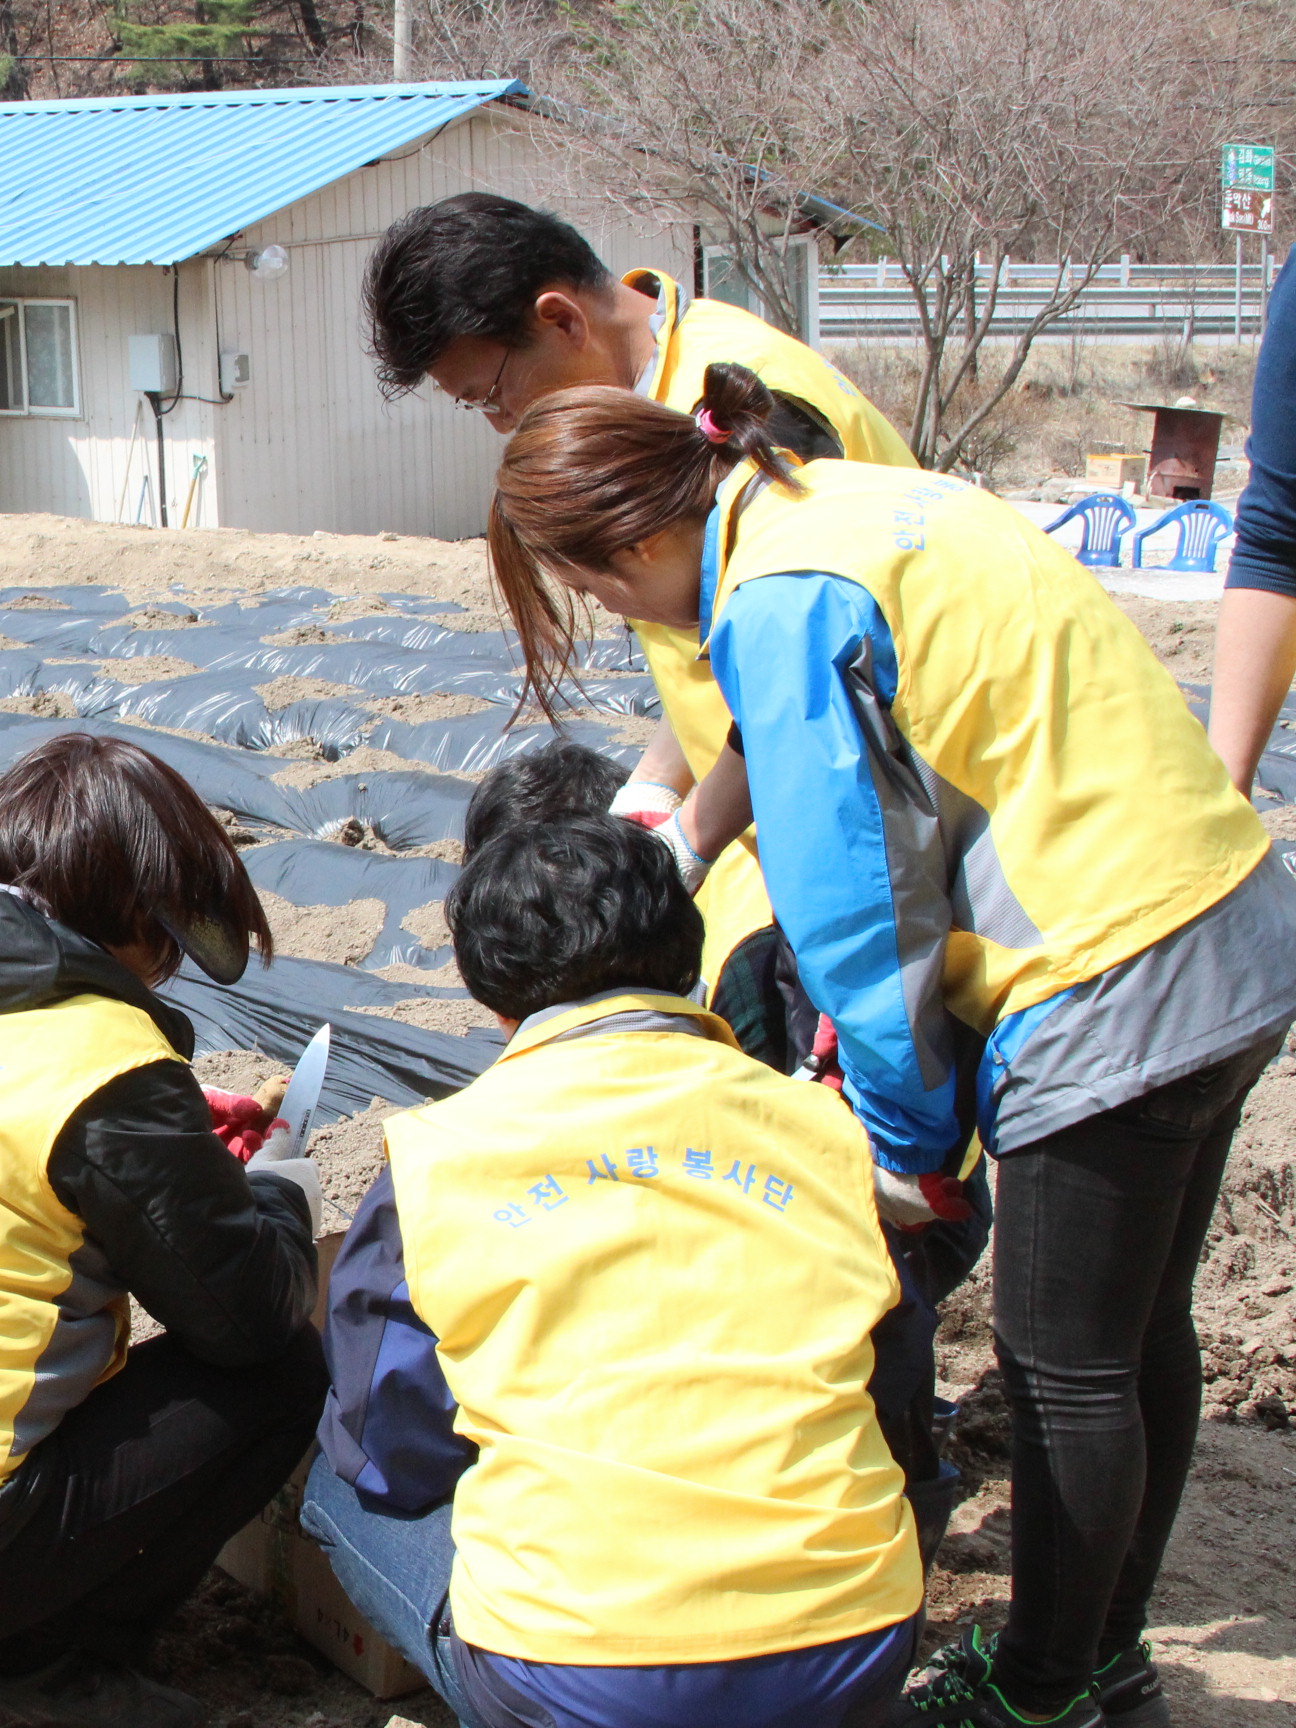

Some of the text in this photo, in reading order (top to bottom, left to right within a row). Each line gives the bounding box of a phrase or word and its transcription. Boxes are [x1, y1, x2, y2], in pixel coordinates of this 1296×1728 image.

[903, 486, 944, 509] 사랑
[892, 510, 925, 552] 안전
[492, 1145, 794, 1228] 안전 사랑 봉사단
